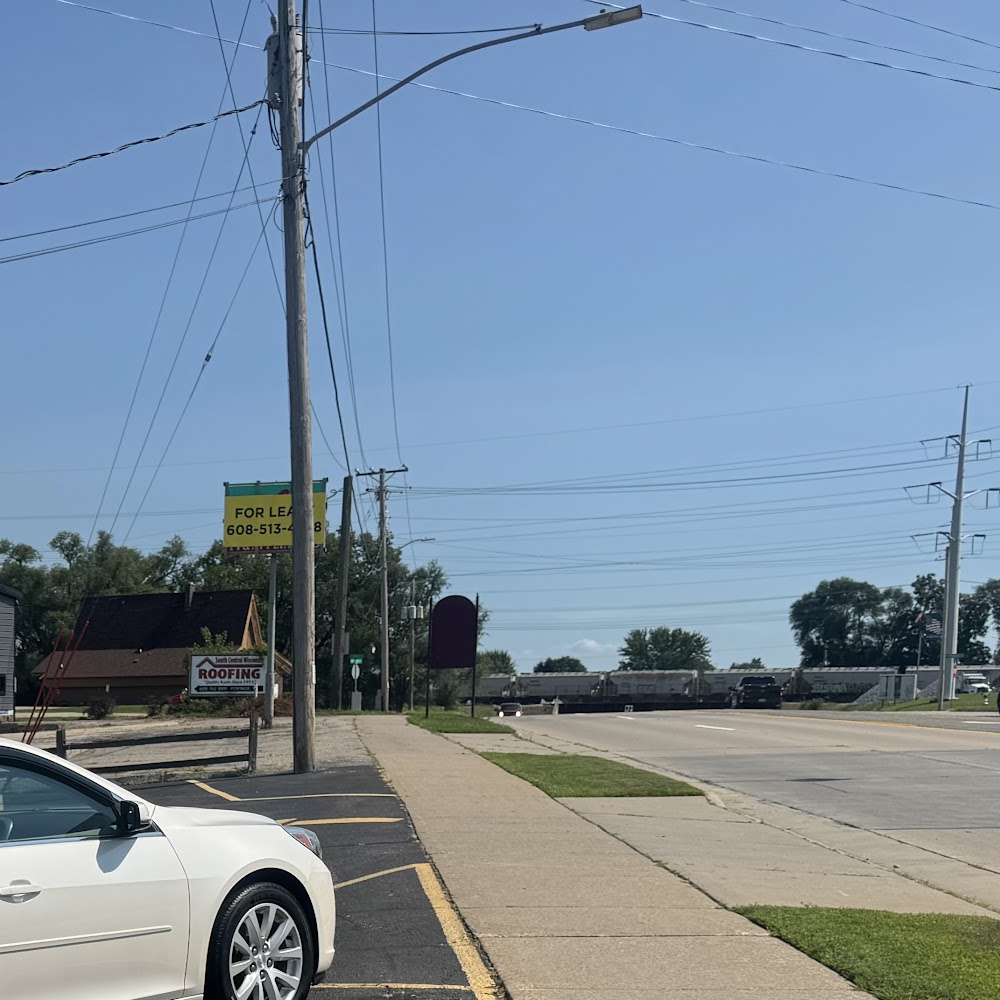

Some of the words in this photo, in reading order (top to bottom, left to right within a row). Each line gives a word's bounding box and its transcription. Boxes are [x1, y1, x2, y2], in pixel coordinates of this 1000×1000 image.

[235, 507, 264, 518] FOR
[226, 521, 322, 536] 608-513-48
[198, 668, 260, 679] ROOFING
